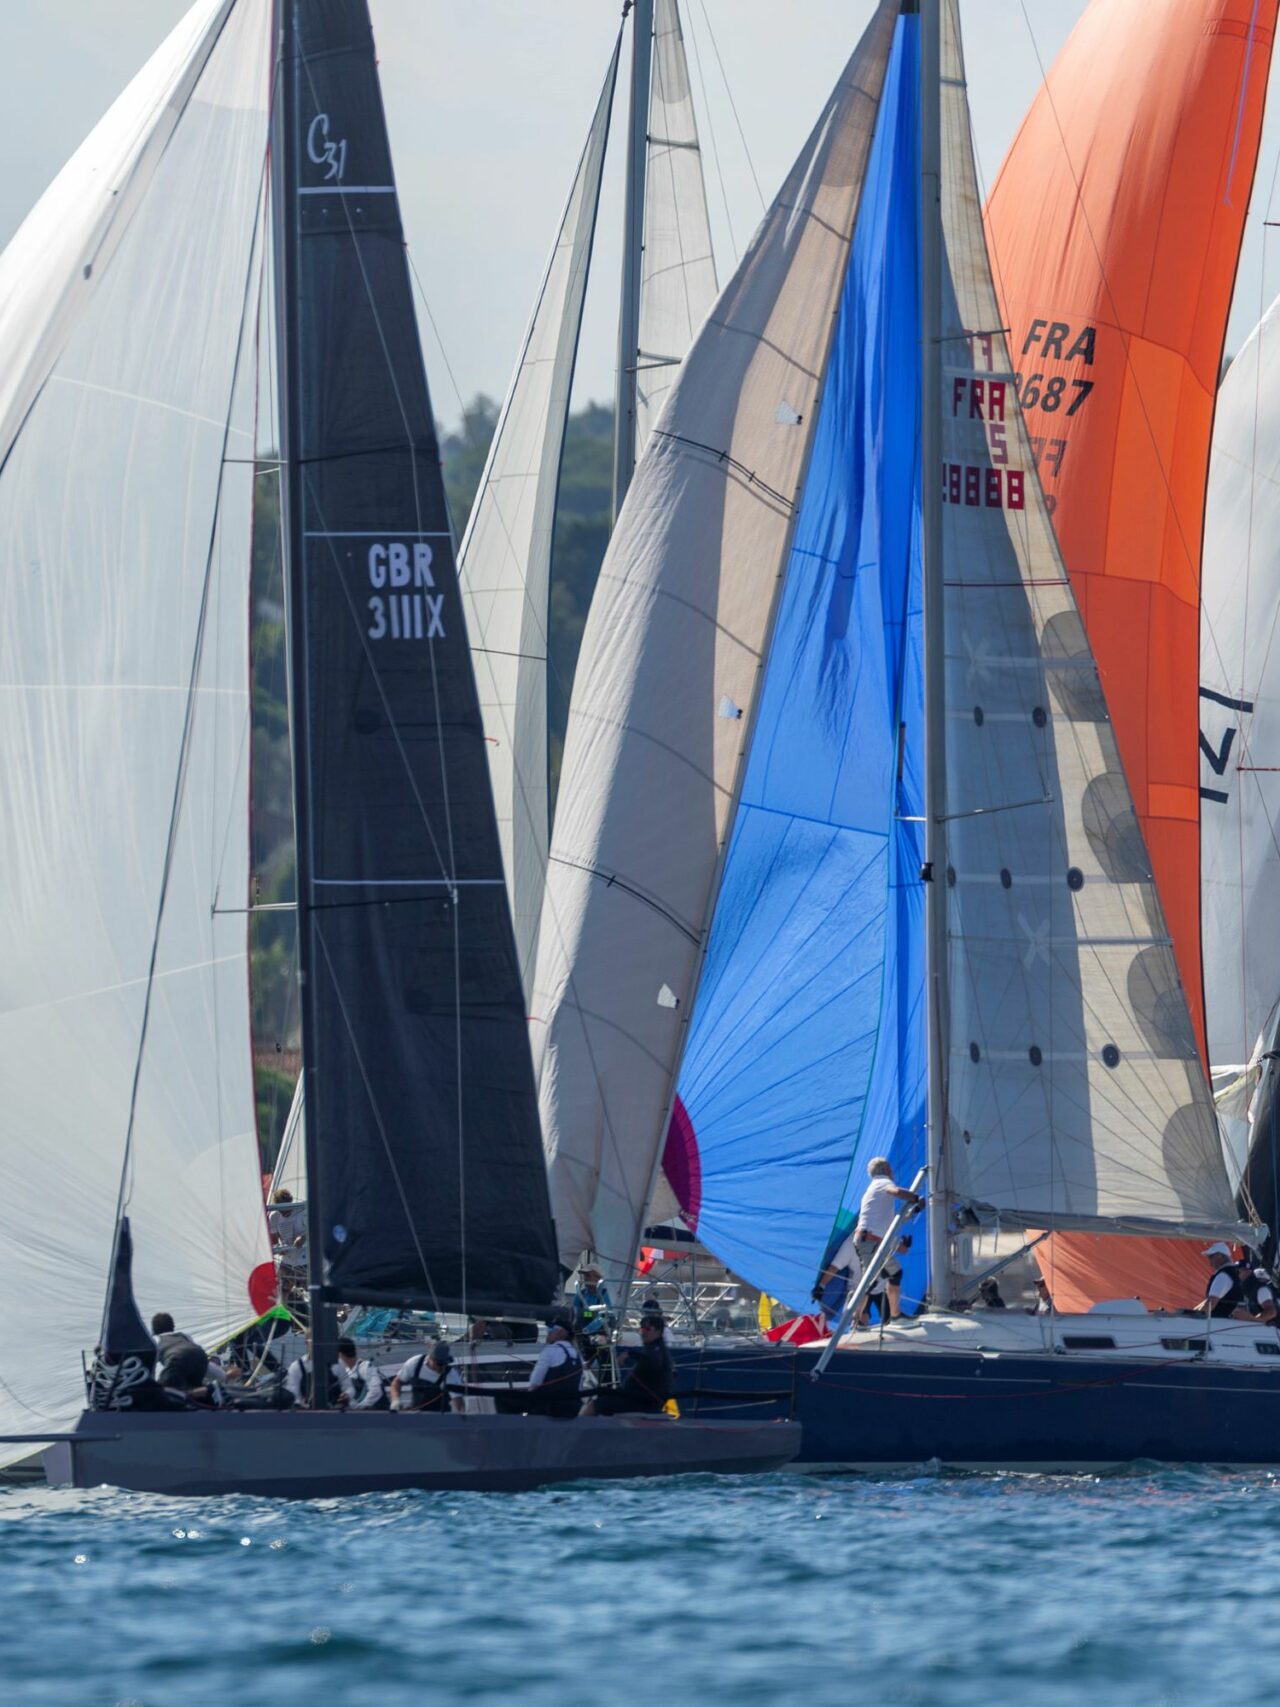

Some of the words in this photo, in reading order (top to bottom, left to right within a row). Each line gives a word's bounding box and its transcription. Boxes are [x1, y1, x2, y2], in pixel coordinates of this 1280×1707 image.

[1022, 319, 1097, 366] FRA
[953, 377, 1007, 422] FRA
[367, 543, 436, 589] GBR
